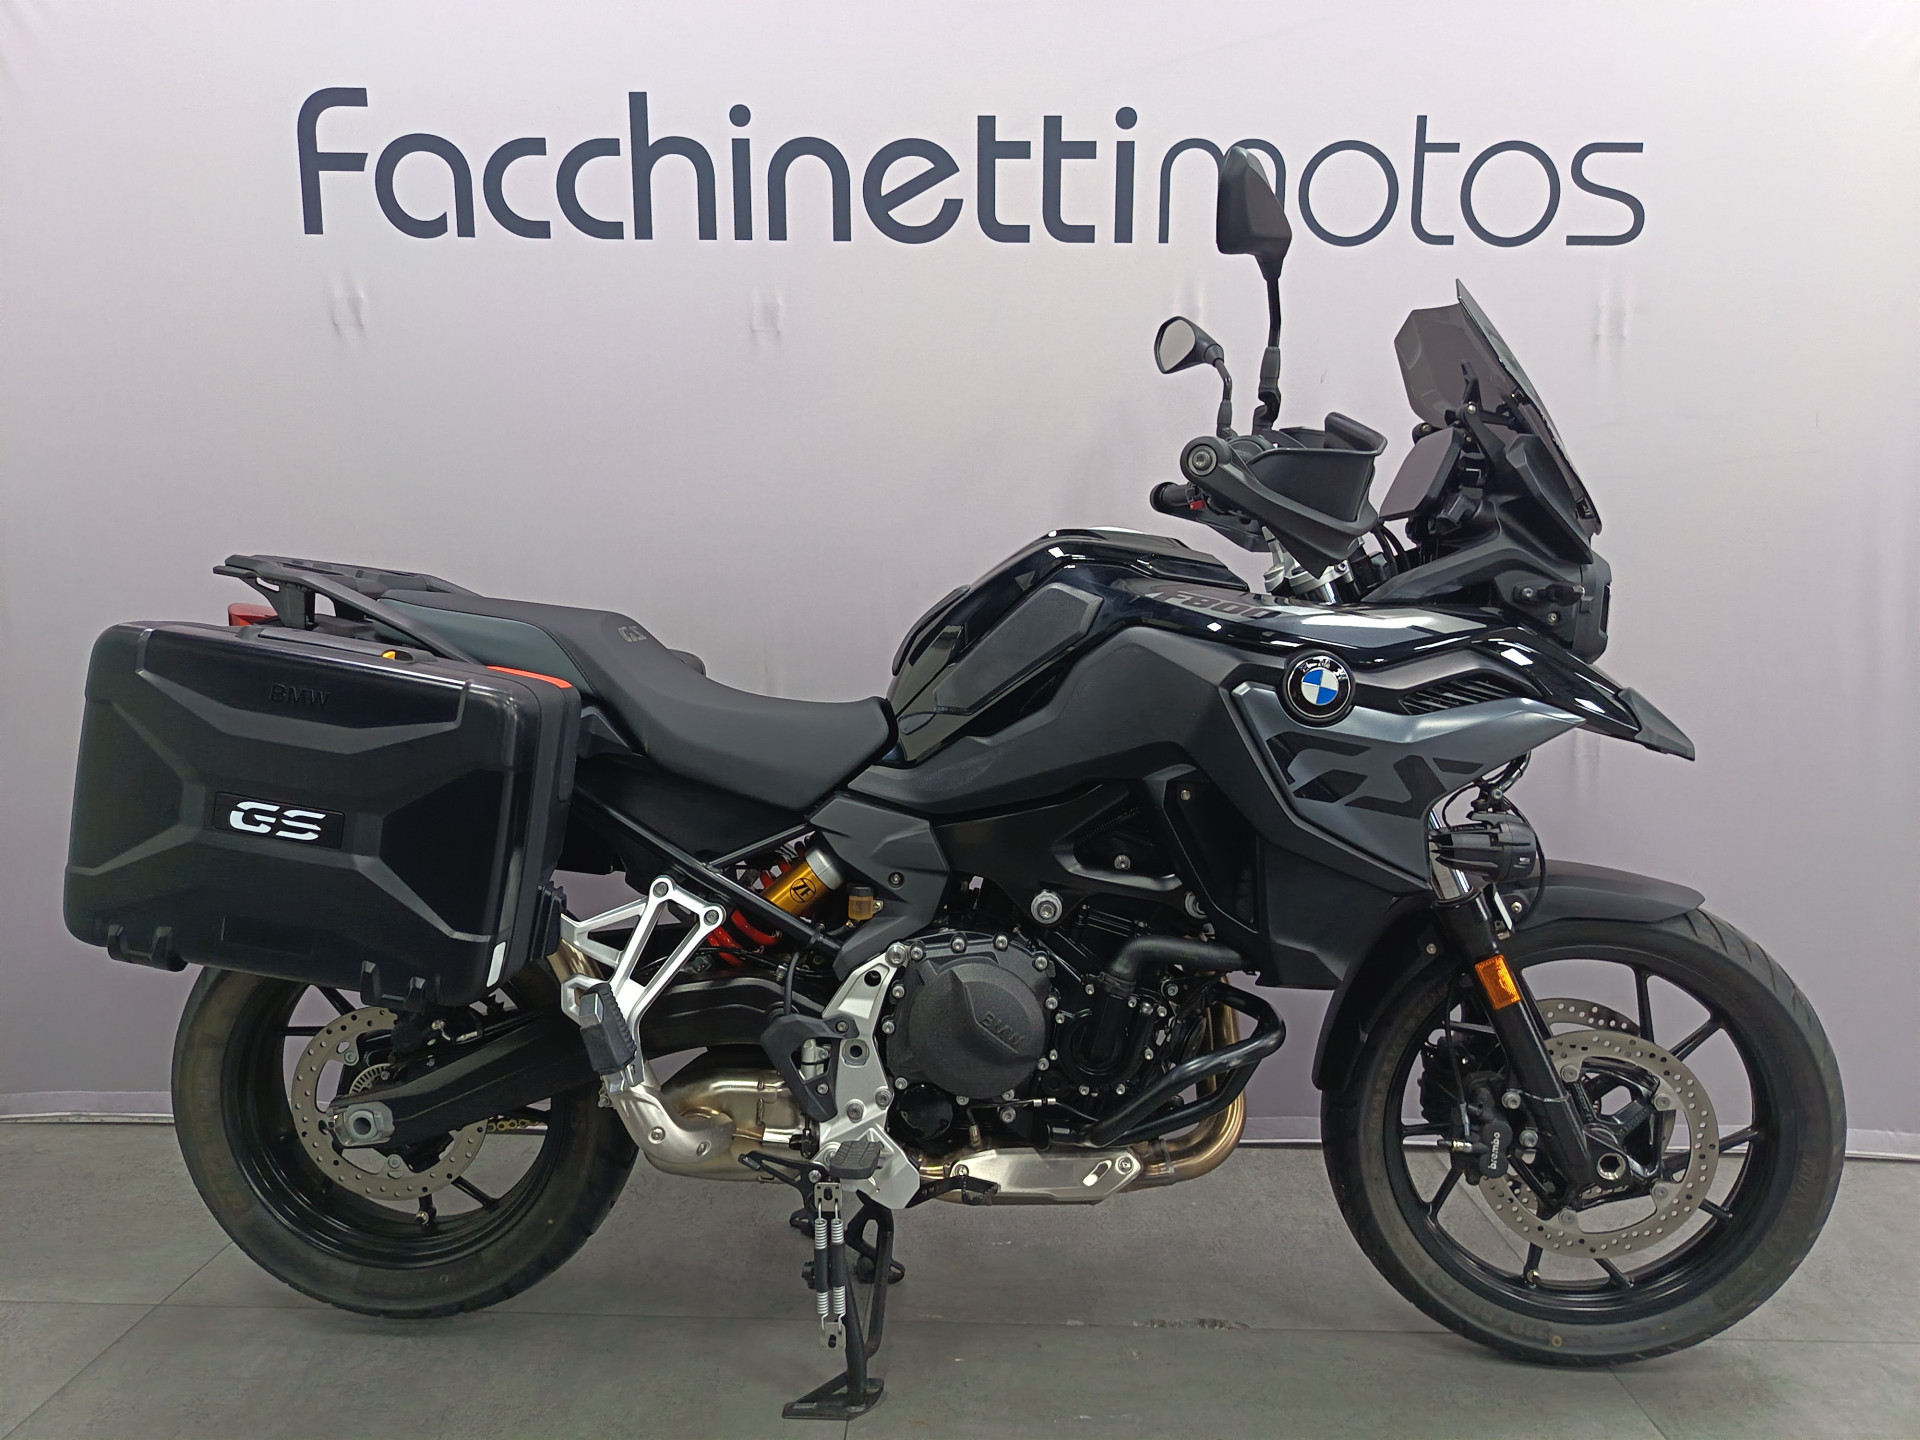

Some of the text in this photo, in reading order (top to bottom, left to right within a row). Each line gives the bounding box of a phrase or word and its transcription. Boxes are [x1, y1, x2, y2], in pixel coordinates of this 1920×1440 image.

[267, 681, 332, 708] BMW
[229, 800, 327, 841] GS
[790, 878, 816, 903] ZF
[981, 1010, 1025, 1046] BMW
[1487, 1131, 1501, 1170] brembo
